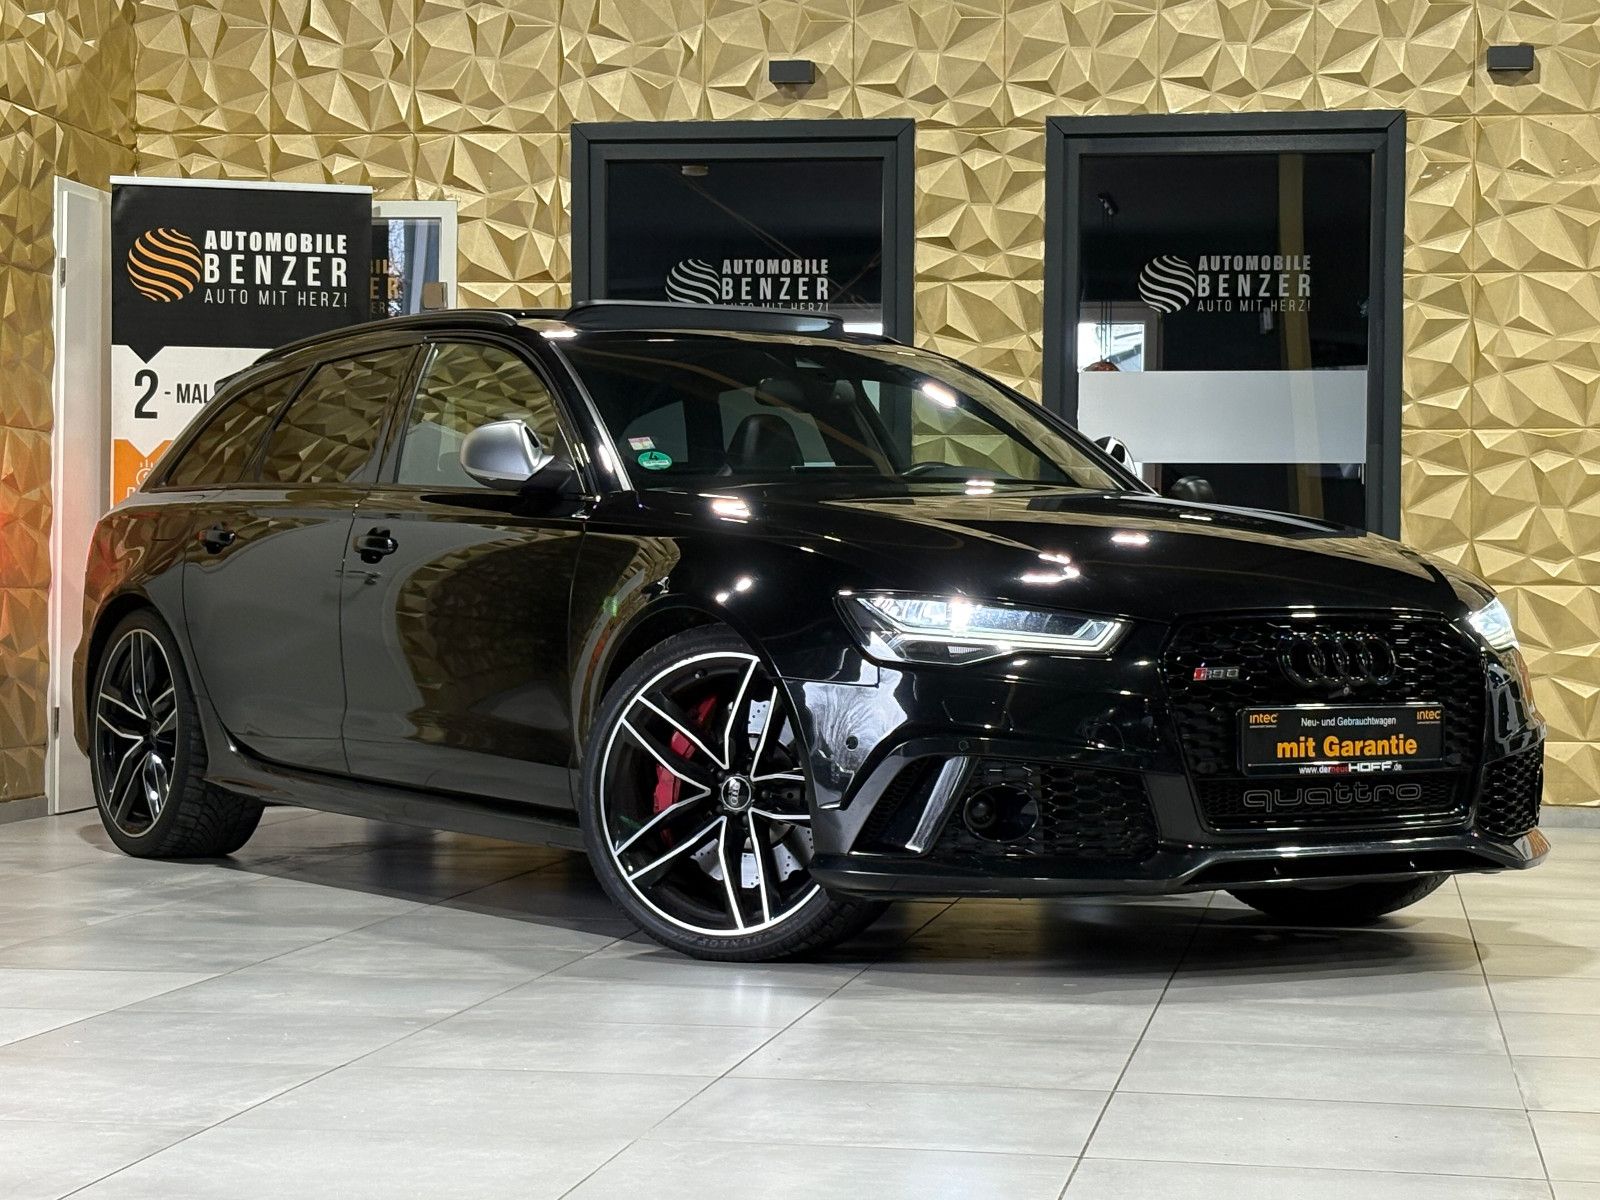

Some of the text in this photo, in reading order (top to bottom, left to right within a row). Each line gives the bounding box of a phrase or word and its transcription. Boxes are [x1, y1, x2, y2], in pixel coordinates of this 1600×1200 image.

[204, 230, 347, 254] AUTOMOBILE
[204, 253, 347, 287] BENZER
[721, 258, 829, 274] AUTOMOBILE
[1198, 255, 1311, 271] AUTOMOBILE
[721, 277, 829, 300] BENZER
[1197, 273, 1311, 297] BENZER
[204, 288, 347, 307] AUTO MIT HERZ!
[1197, 299, 1311, 312] AUTO MIT HERZ!
[134, 369, 159, 419] 2
[176, 383, 208, 404] MAL
[1249, 712, 1278, 724] intec
[1301, 715, 1397, 728] Neu- und Gebrauchtwagen
[1416, 709, 1441, 720] intec
[1277, 733, 1418, 758] mit Garantie
[1243, 782, 1422, 813] quattro
